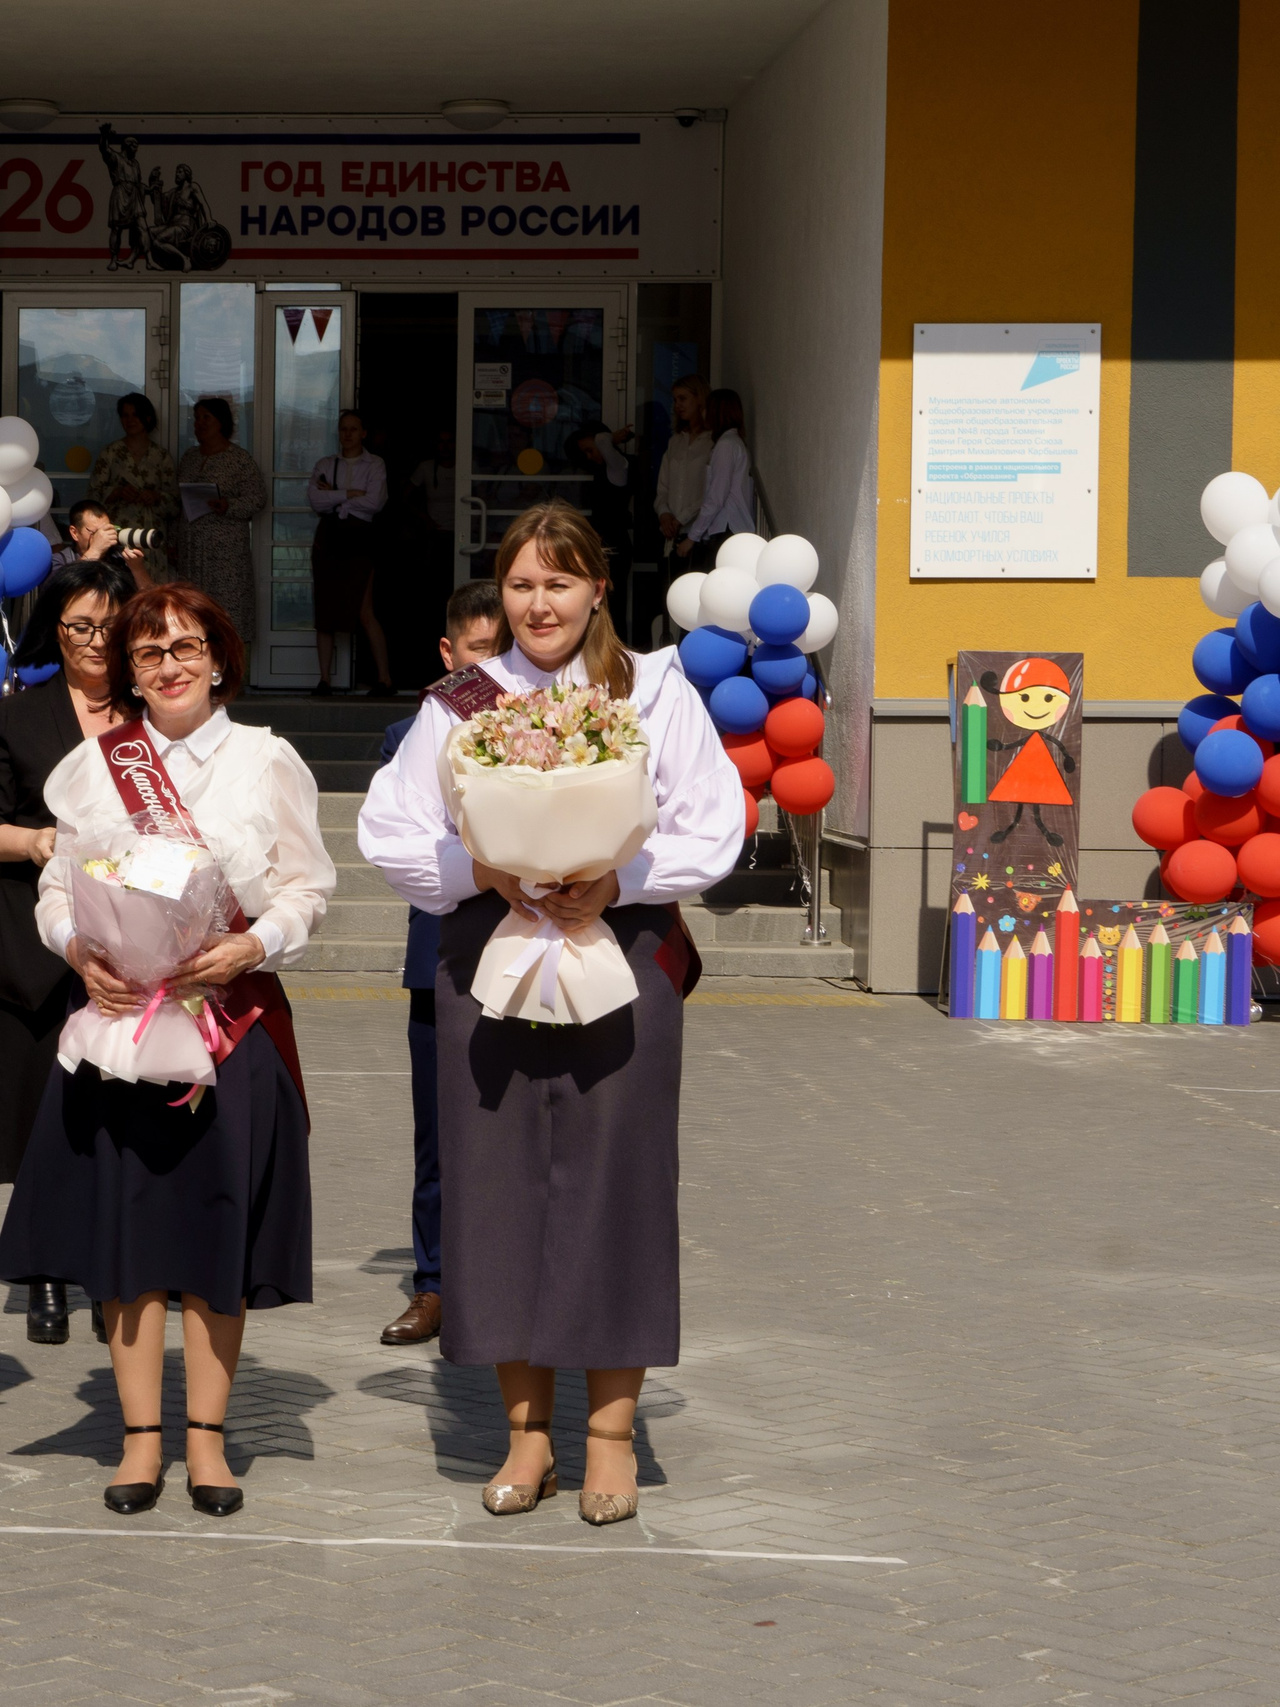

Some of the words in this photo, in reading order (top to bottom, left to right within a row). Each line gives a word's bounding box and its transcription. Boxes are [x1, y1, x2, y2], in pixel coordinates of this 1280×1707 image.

[241, 160, 325, 198] ГОД
[342, 160, 570, 198] ЕДИНСТВА
[240, 204, 445, 241] НАРОДОВ
[461, 204, 640, 238] РОССИИ
[928, 397, 997, 406] Муниципальное
[928, 406, 1025, 416] общеобразовательное
[1028, 408, 1080, 416] учреждение
[928, 418, 964, 426] средняя
[966, 417, 1063, 426] общеобразовательная
[980, 428, 1009, 436] города
[957, 438, 982, 446] Героя
[928, 448, 966, 457] Дмитрия
[1028, 448, 1078, 456] Карбышева
[1003, 464, 1059, 472] национального
[960, 473, 1016, 481] «Образование»
[925, 491, 1006, 505] НАЦИОНАЛЬНЫЕ
[1008, 491, 1054, 504] ПРОЕКТЫ
[925, 510, 982, 524] РАБОТАЮТ,
[984, 510, 1018, 524] ЧТОБЫ
[1020, 510, 1043, 524] ВАШ
[925, 530, 968, 543] РЕБЕНОК
[970, 530, 1010, 543] УЧИЛСЯ
[924, 550, 930, 562] В
[933, 549, 1004, 562] КОМФОРТНЫХ
[1006, 549, 1059, 562] УСЛОВИЯХ
[110, 739, 182, 836] Классный
